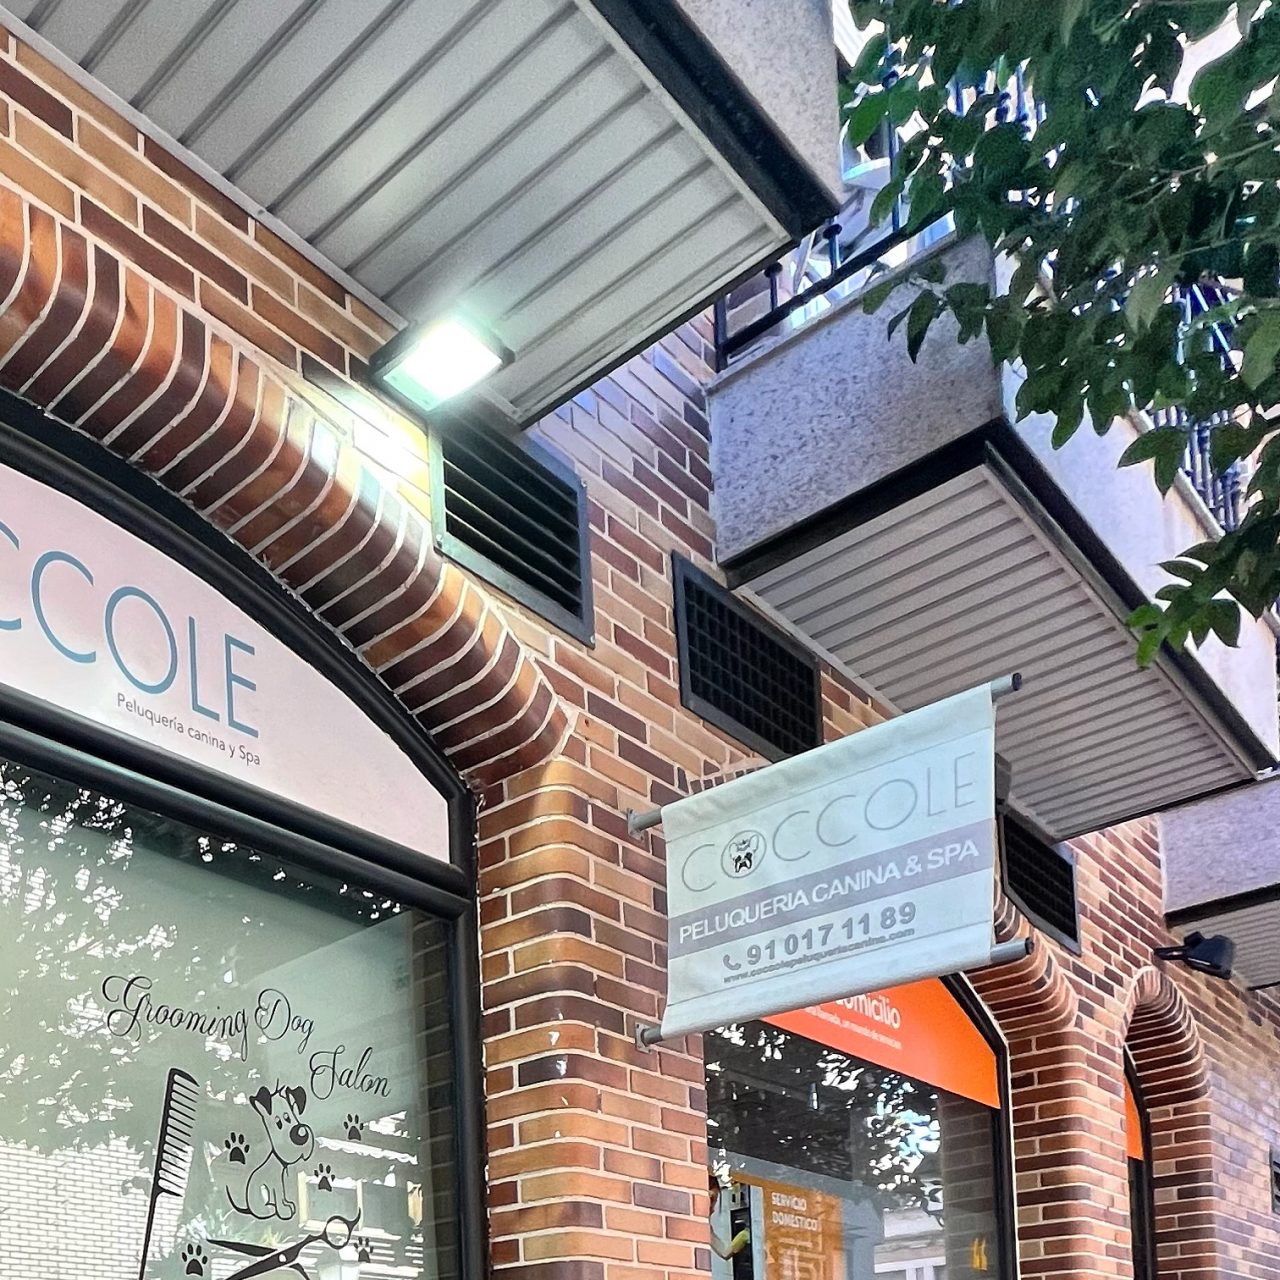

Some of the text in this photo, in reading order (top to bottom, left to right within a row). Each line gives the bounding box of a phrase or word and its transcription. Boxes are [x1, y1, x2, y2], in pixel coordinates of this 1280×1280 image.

[117, 692, 261, 766] Peluquería canina y Spa
[681, 751, 976, 893] COCCOLE
[678, 838, 980, 944] PELUQUERIA CANINA & SPA
[746, 901, 917, 966] 91 017 11 89
[102, 974, 315, 1062] Grooming Dog
[835, 993, 901, 1030] omicilio
[308, 1044, 391, 1100] Salon
[771, 1191, 807, 1211] SERVICIO
